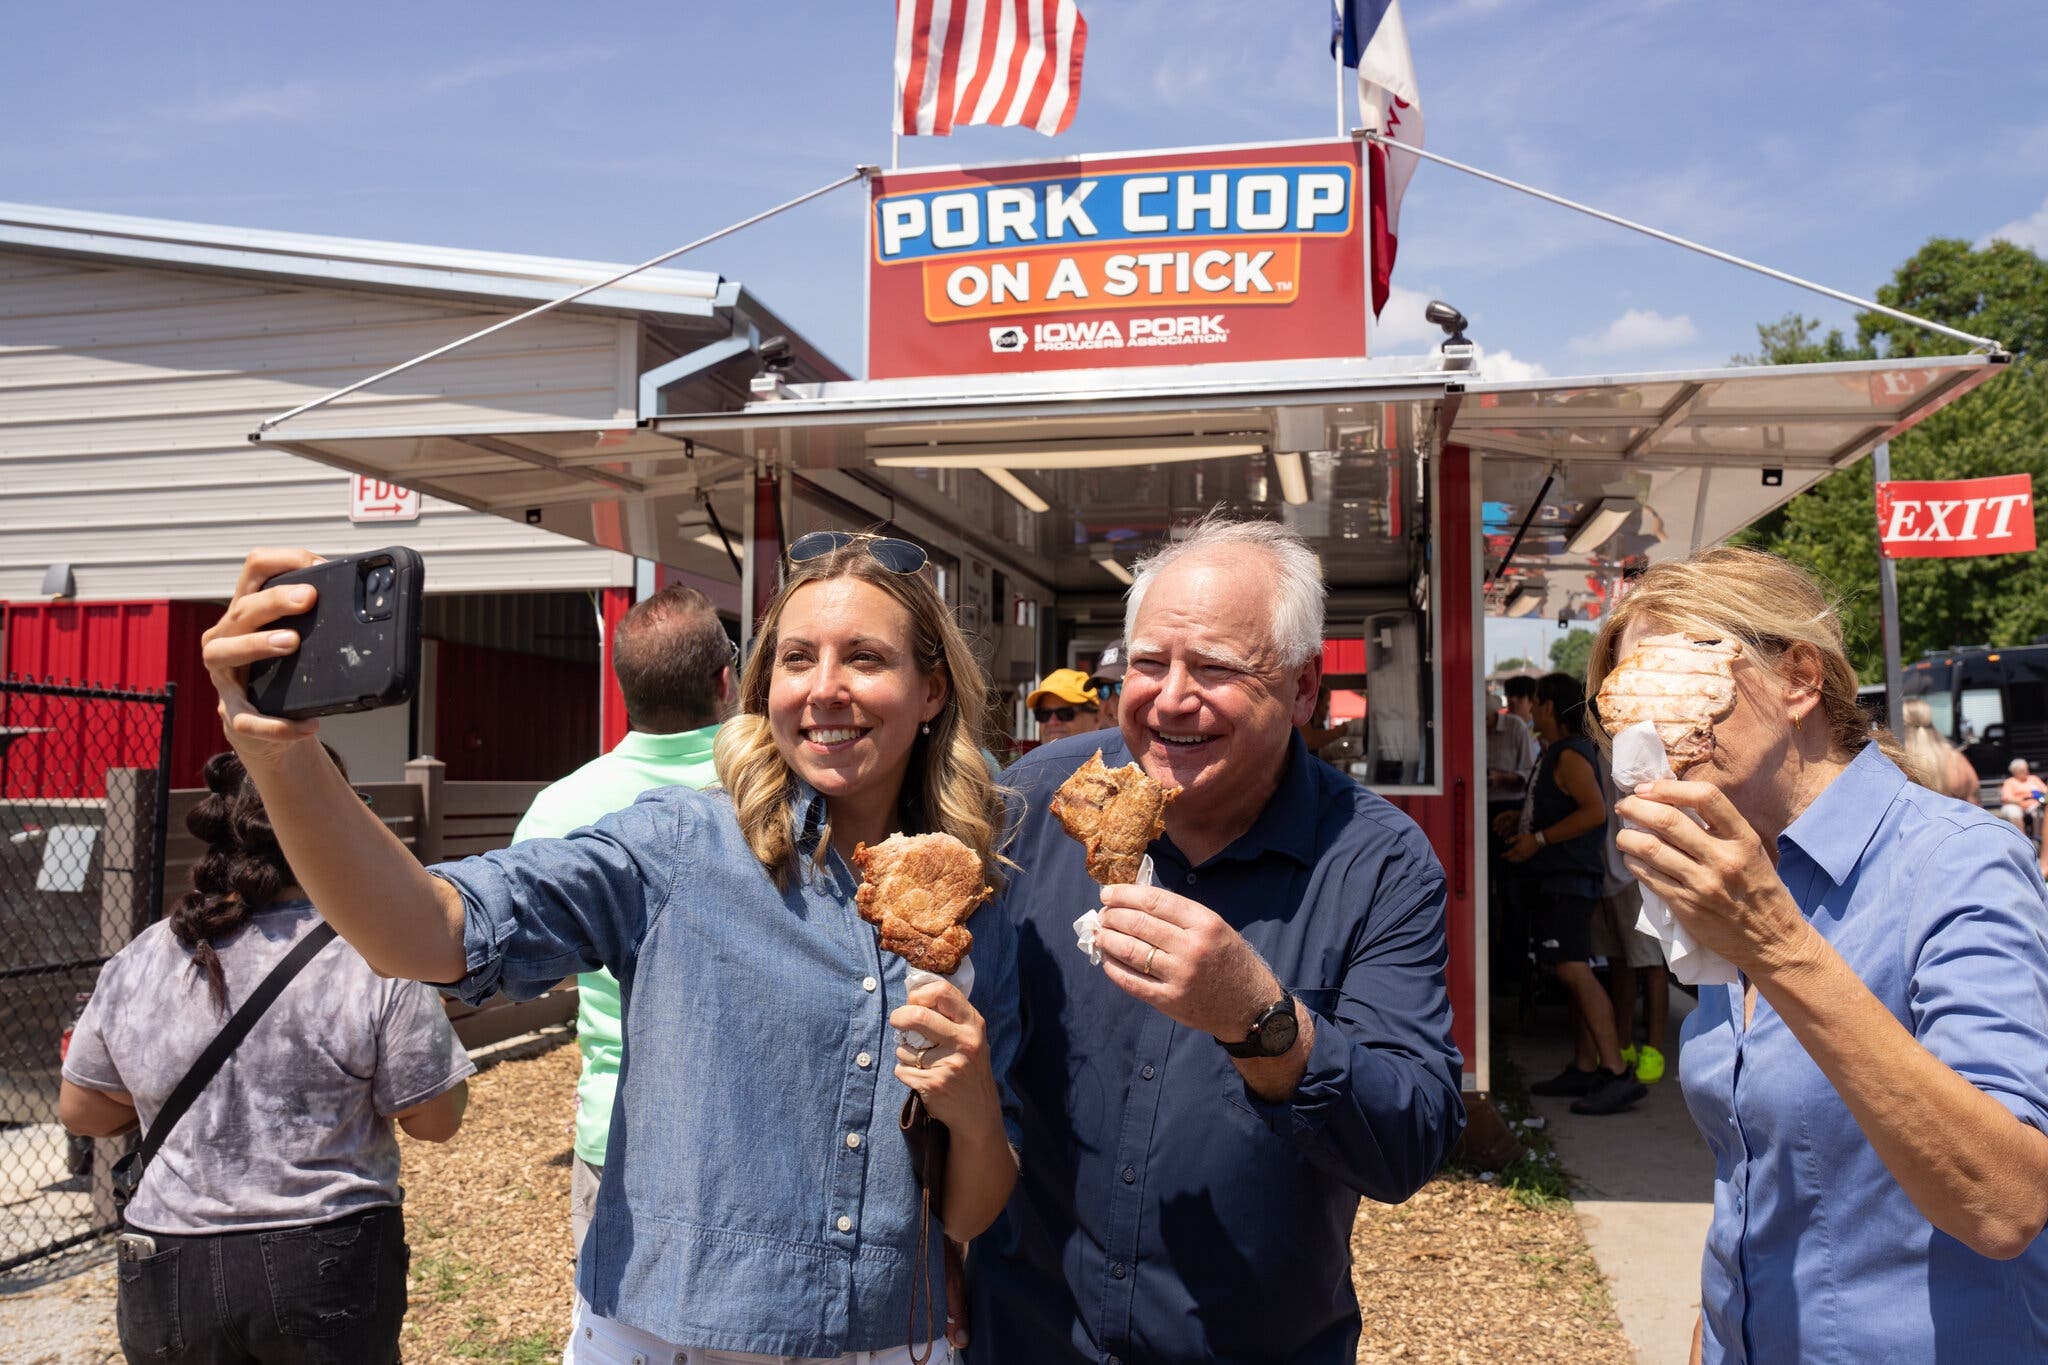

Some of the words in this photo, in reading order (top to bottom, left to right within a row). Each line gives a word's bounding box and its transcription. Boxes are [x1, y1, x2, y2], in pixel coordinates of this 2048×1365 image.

[881, 181, 1099, 255] PORK
[1123, 173, 1346, 232] CHOP
[946, 261, 1030, 306] ON
[1046, 258, 1089, 301] A
[1104, 250, 1275, 297] STICK
[1034, 320, 1123, 343] IOWA
[1129, 314, 1225, 338] PORK
[1034, 338, 1124, 352] PRODUCERS
[1126, 332, 1228, 347] ASSOCIATION
[1881, 493, 2030, 543] EXIT
